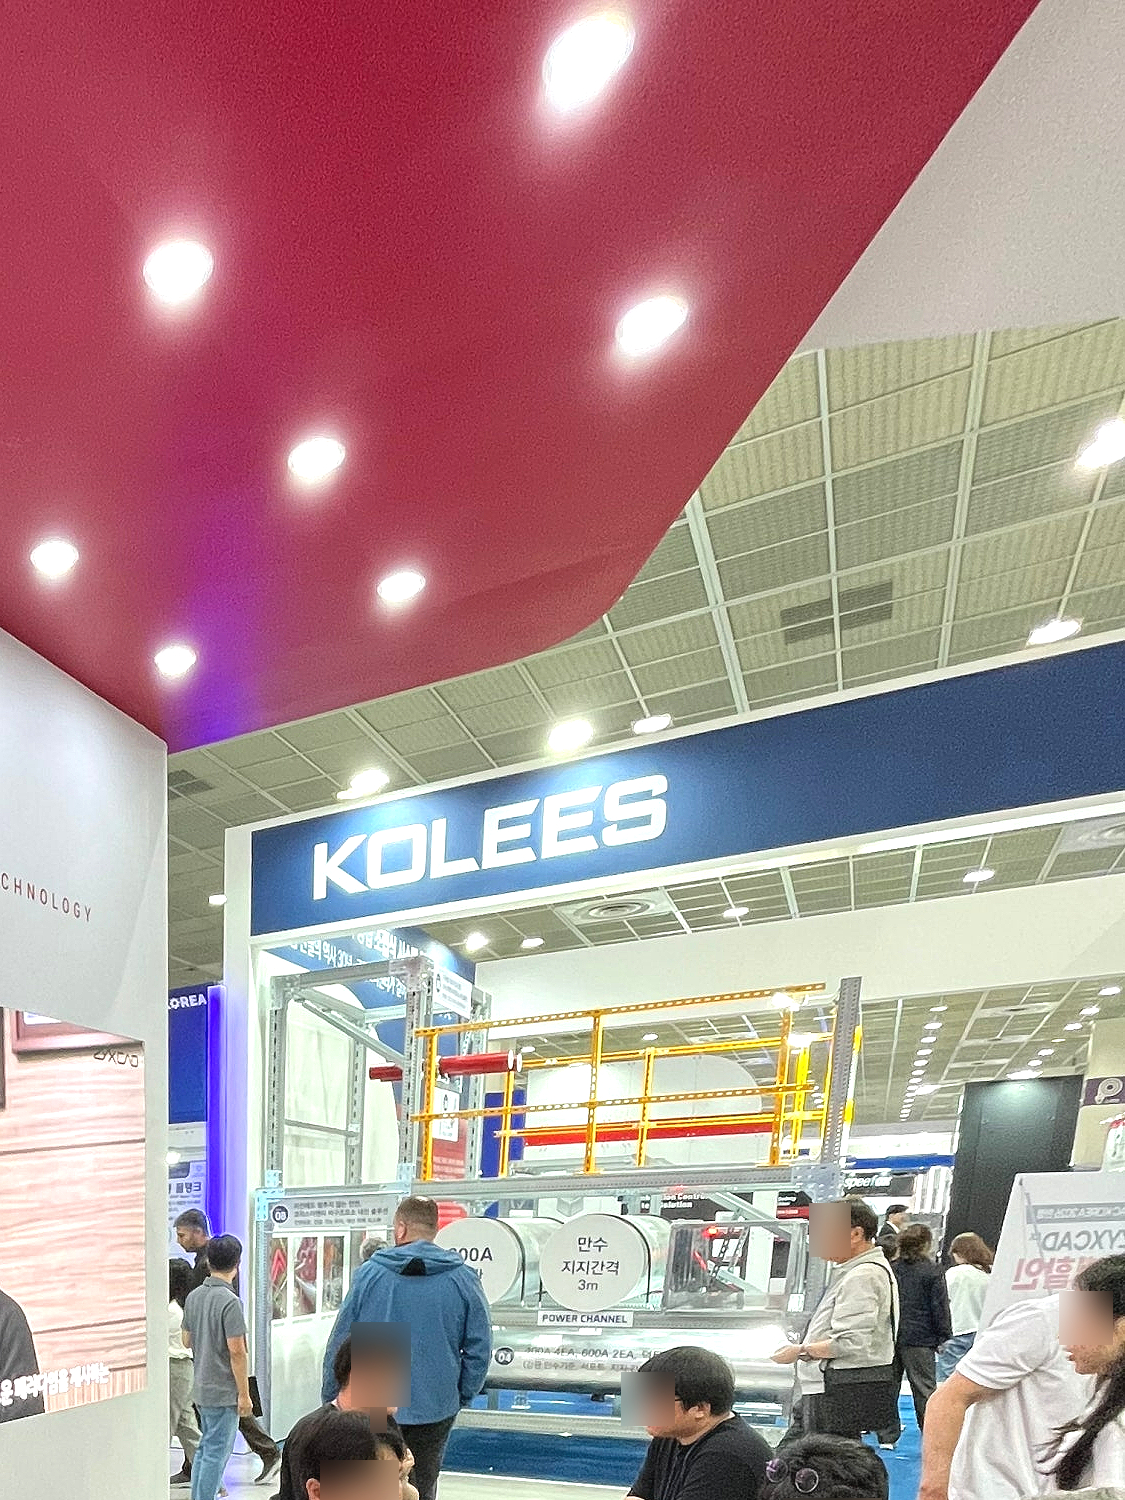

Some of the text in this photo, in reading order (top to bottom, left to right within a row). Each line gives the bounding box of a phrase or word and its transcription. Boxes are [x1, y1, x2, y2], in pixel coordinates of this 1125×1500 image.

[312, 773, 669, 901] KOLEES
[577, 1236, 609, 1253] 만수
[449, 1247, 493, 1263] 00A
[561, 1260, 620, 1276] 지지간격
[577, 1279, 599, 1292] 3m
[541, 1314, 628, 1324] POWER CHANNEL
[498, 1353, 513, 1363] 04
[581, 1349, 609, 1359] 600A
